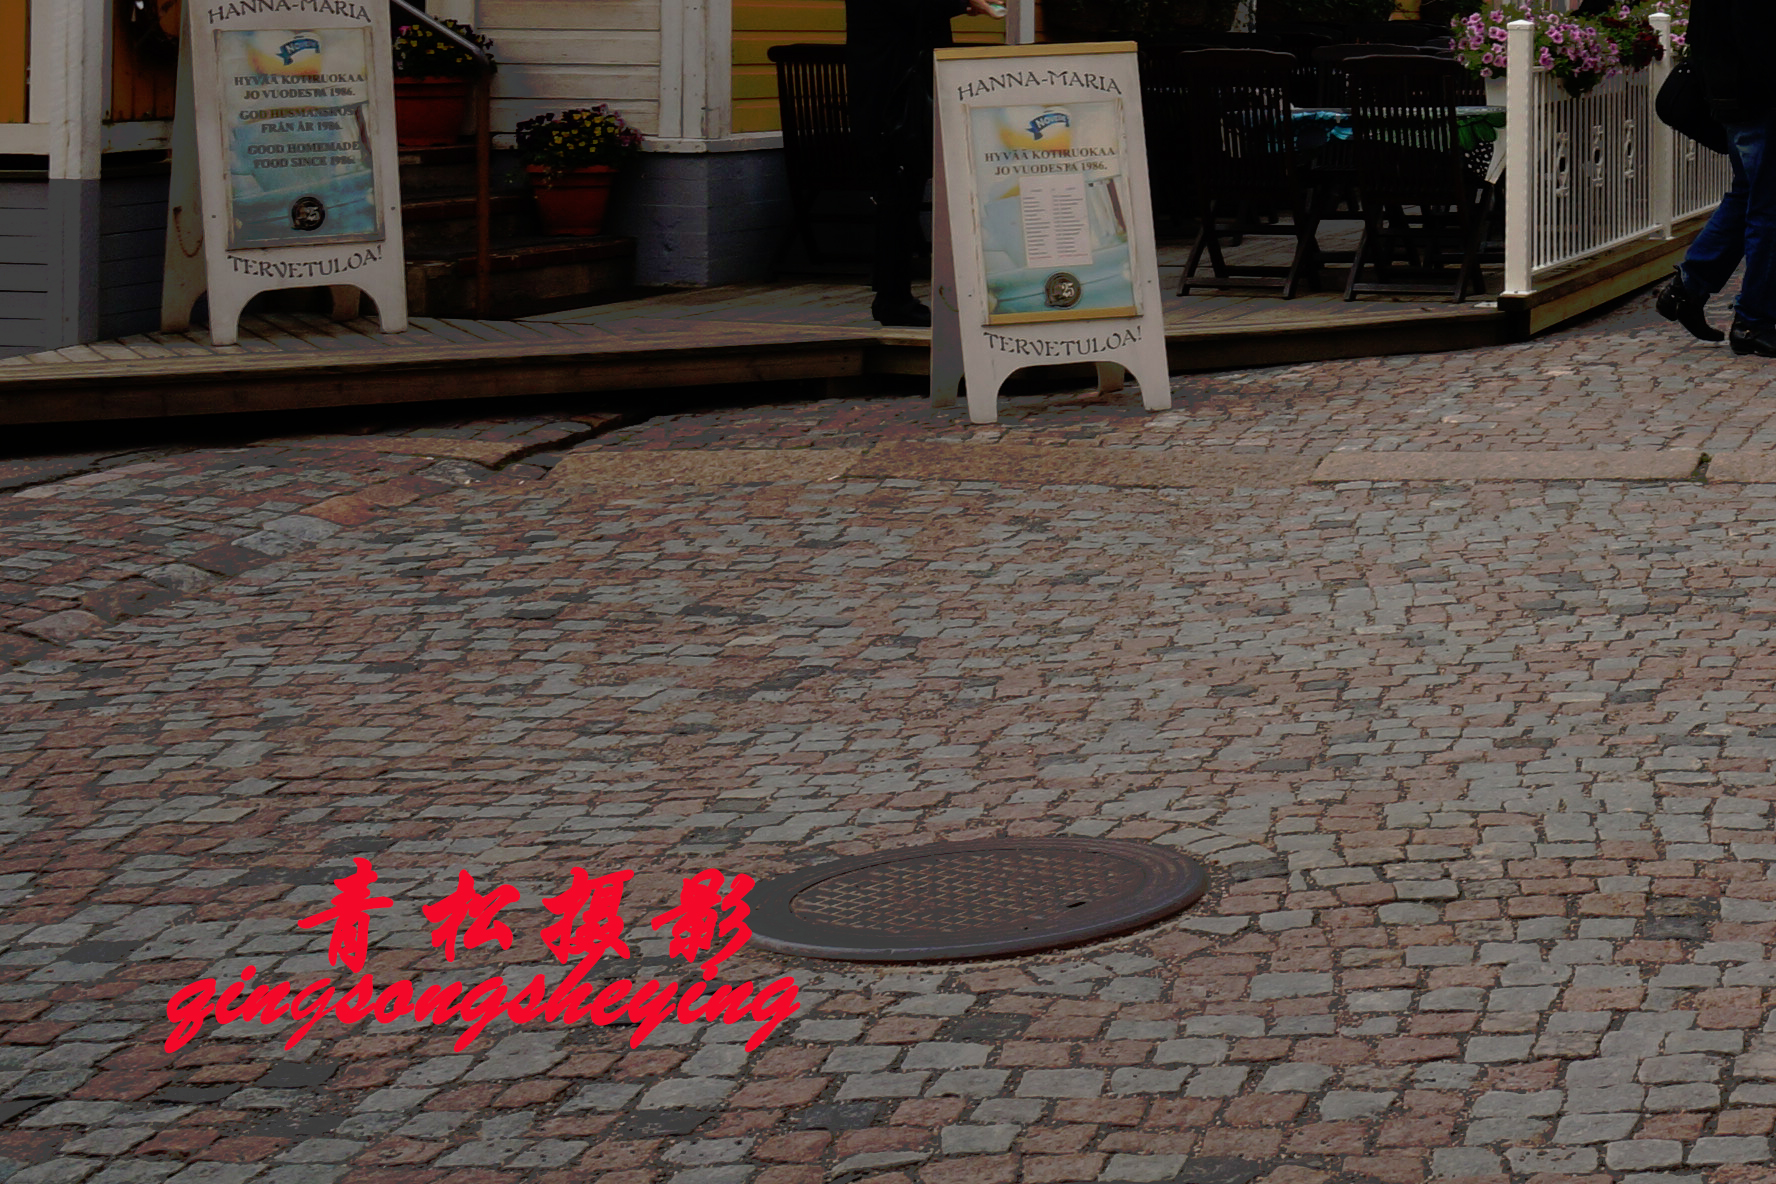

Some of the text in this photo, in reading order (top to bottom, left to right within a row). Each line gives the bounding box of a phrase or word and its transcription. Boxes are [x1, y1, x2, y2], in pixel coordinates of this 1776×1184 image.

[234, 73, 364, 86] HYVÄÄ KOTIRUOKAA
[957, 70, 1122, 101] HANNA-MARIA
[244, 90, 260, 100] JO
[262, 88, 327, 99] VUODESTA
[239, 109, 268, 120] GOD
[261, 122, 295, 134] FRÅN
[297, 121, 314, 132] ÅR
[248, 141, 360, 155] GOOD HOMEMADE
[984, 146, 1116, 163] HYVÄÄ KOTIRUOKAA
[254, 158, 289, 169] FOOD
[291, 156, 328, 168] SINCE
[994, 161, 1108, 176] JO VUODESTA 1986.
[227, 245, 382, 279] TERVETULOA!
[1061, 281, 1075, 297] 25
[983, 326, 1142, 357] TERVETULOA!
